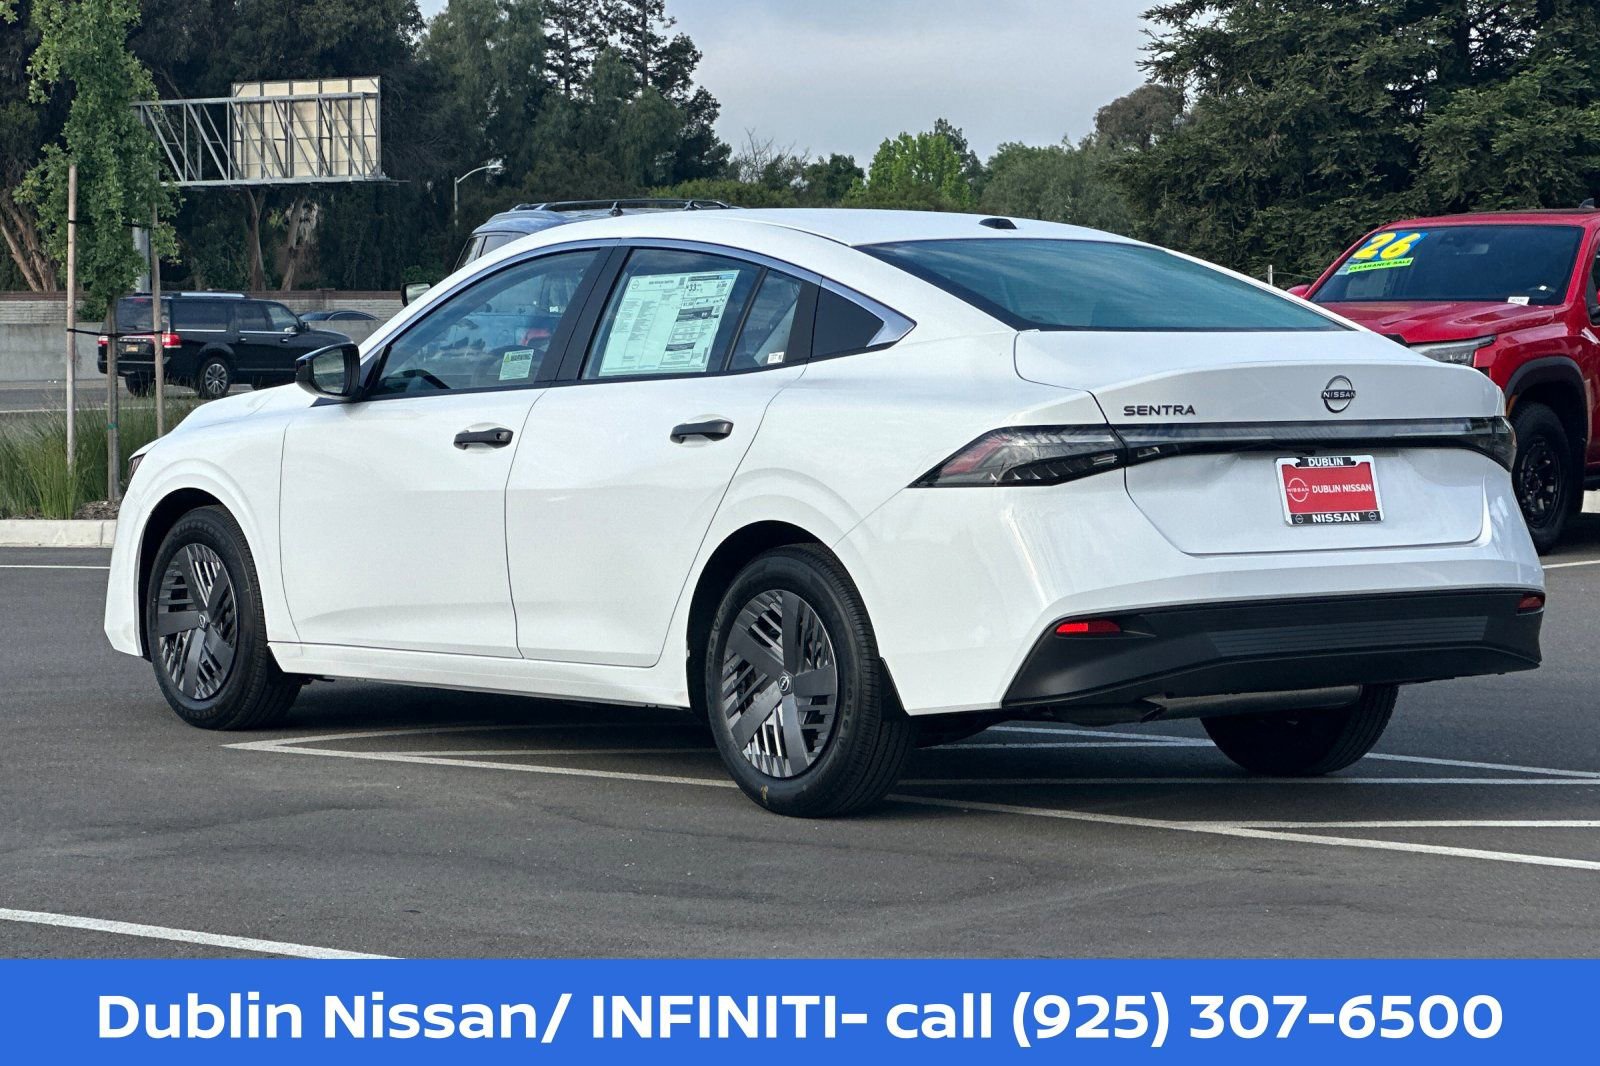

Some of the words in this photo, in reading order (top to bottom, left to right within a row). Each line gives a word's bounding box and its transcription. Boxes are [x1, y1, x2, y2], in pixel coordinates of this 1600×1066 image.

[1352, 232, 1421, 260] 26
[1349, 261, 1391, 270] CLEARANCE
[1322, 390, 1356, 399] NISSAN
[1123, 404, 1196, 417] SENTRA
[1307, 456, 1345, 467] DUBLIN
[1311, 484, 1342, 494] DUBLIN
[1342, 483, 1373, 493] NISSAN
[1311, 512, 1360, 523] NISSAN
